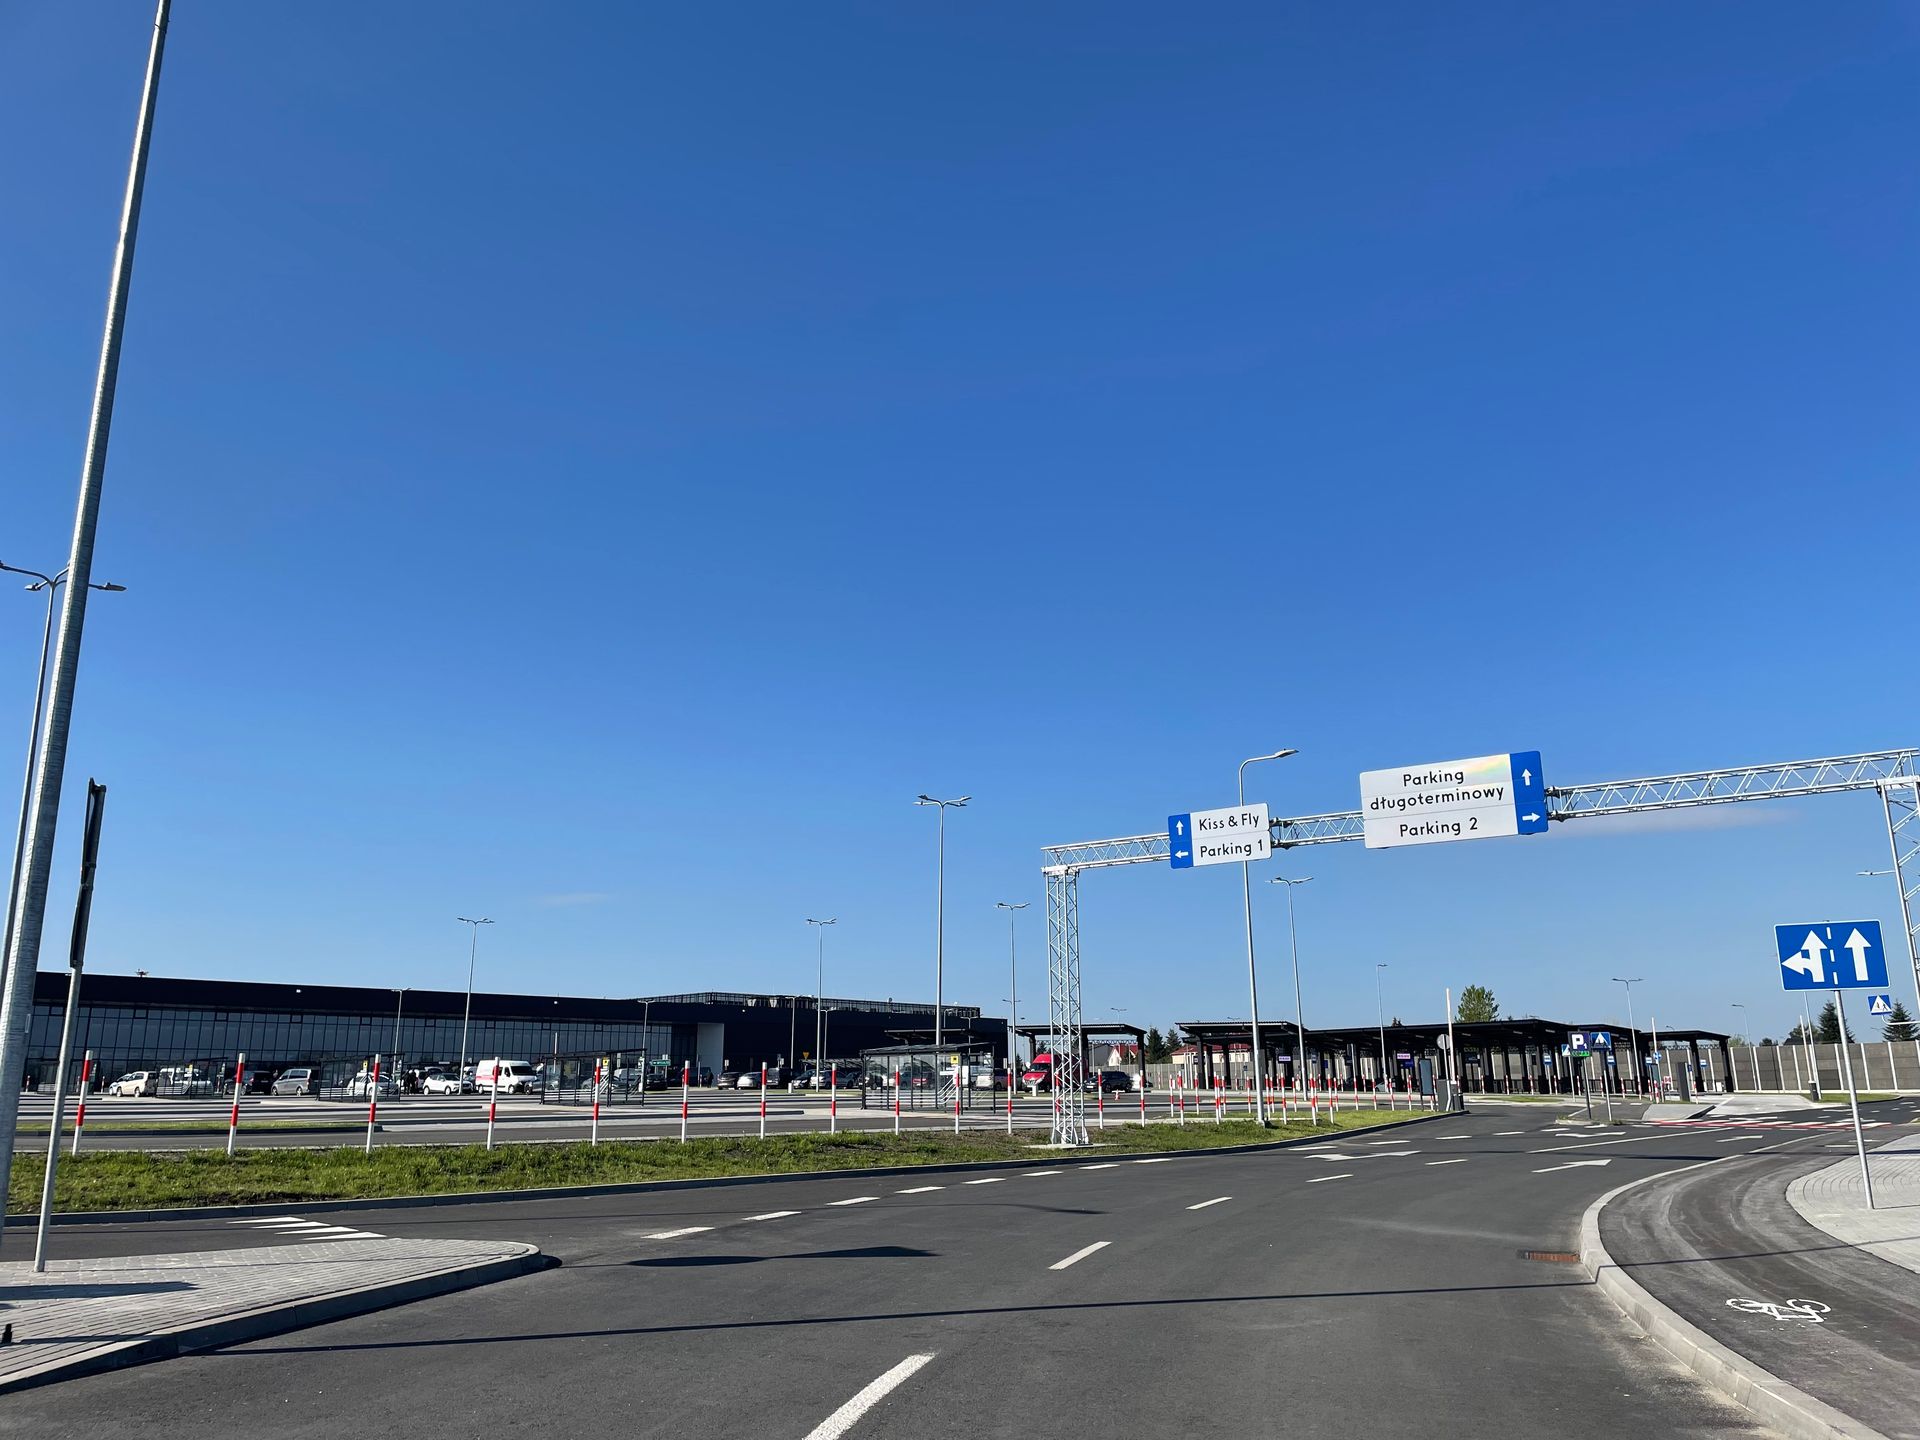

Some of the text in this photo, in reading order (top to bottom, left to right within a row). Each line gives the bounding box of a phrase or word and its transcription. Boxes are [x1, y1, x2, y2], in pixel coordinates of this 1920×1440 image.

[1403, 770, 1464, 787] Parking
[1370, 787, 1504, 811] długoterminowy
[1199, 813, 1259, 831] Kiss & Fly
[1399, 817, 1478, 837] Parking 2
[1200, 839, 1263, 858] Parking 1
